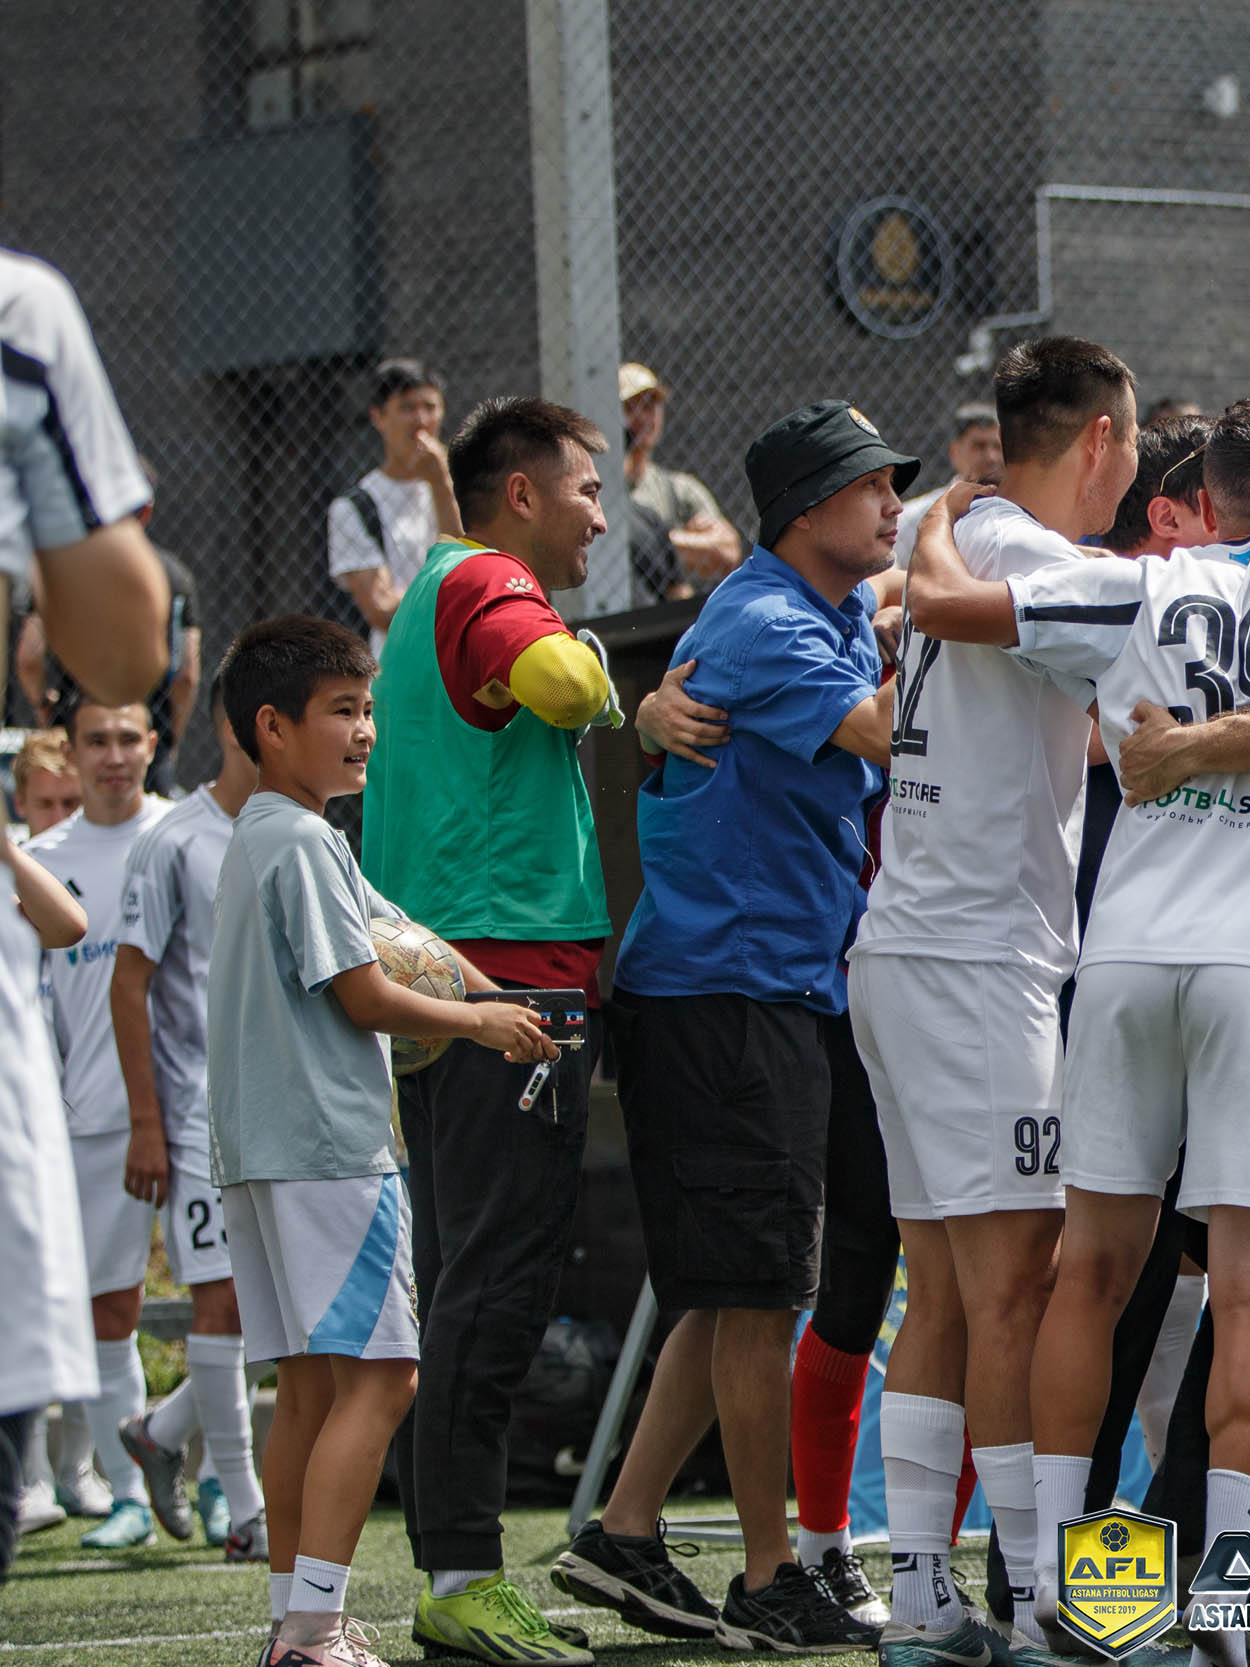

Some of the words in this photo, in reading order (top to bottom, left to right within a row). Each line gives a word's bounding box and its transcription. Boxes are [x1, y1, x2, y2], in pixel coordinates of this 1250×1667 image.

[889, 608, 942, 758] 2
[1014, 1115, 1062, 1177] 92
[187, 1196, 229, 1251] 2
